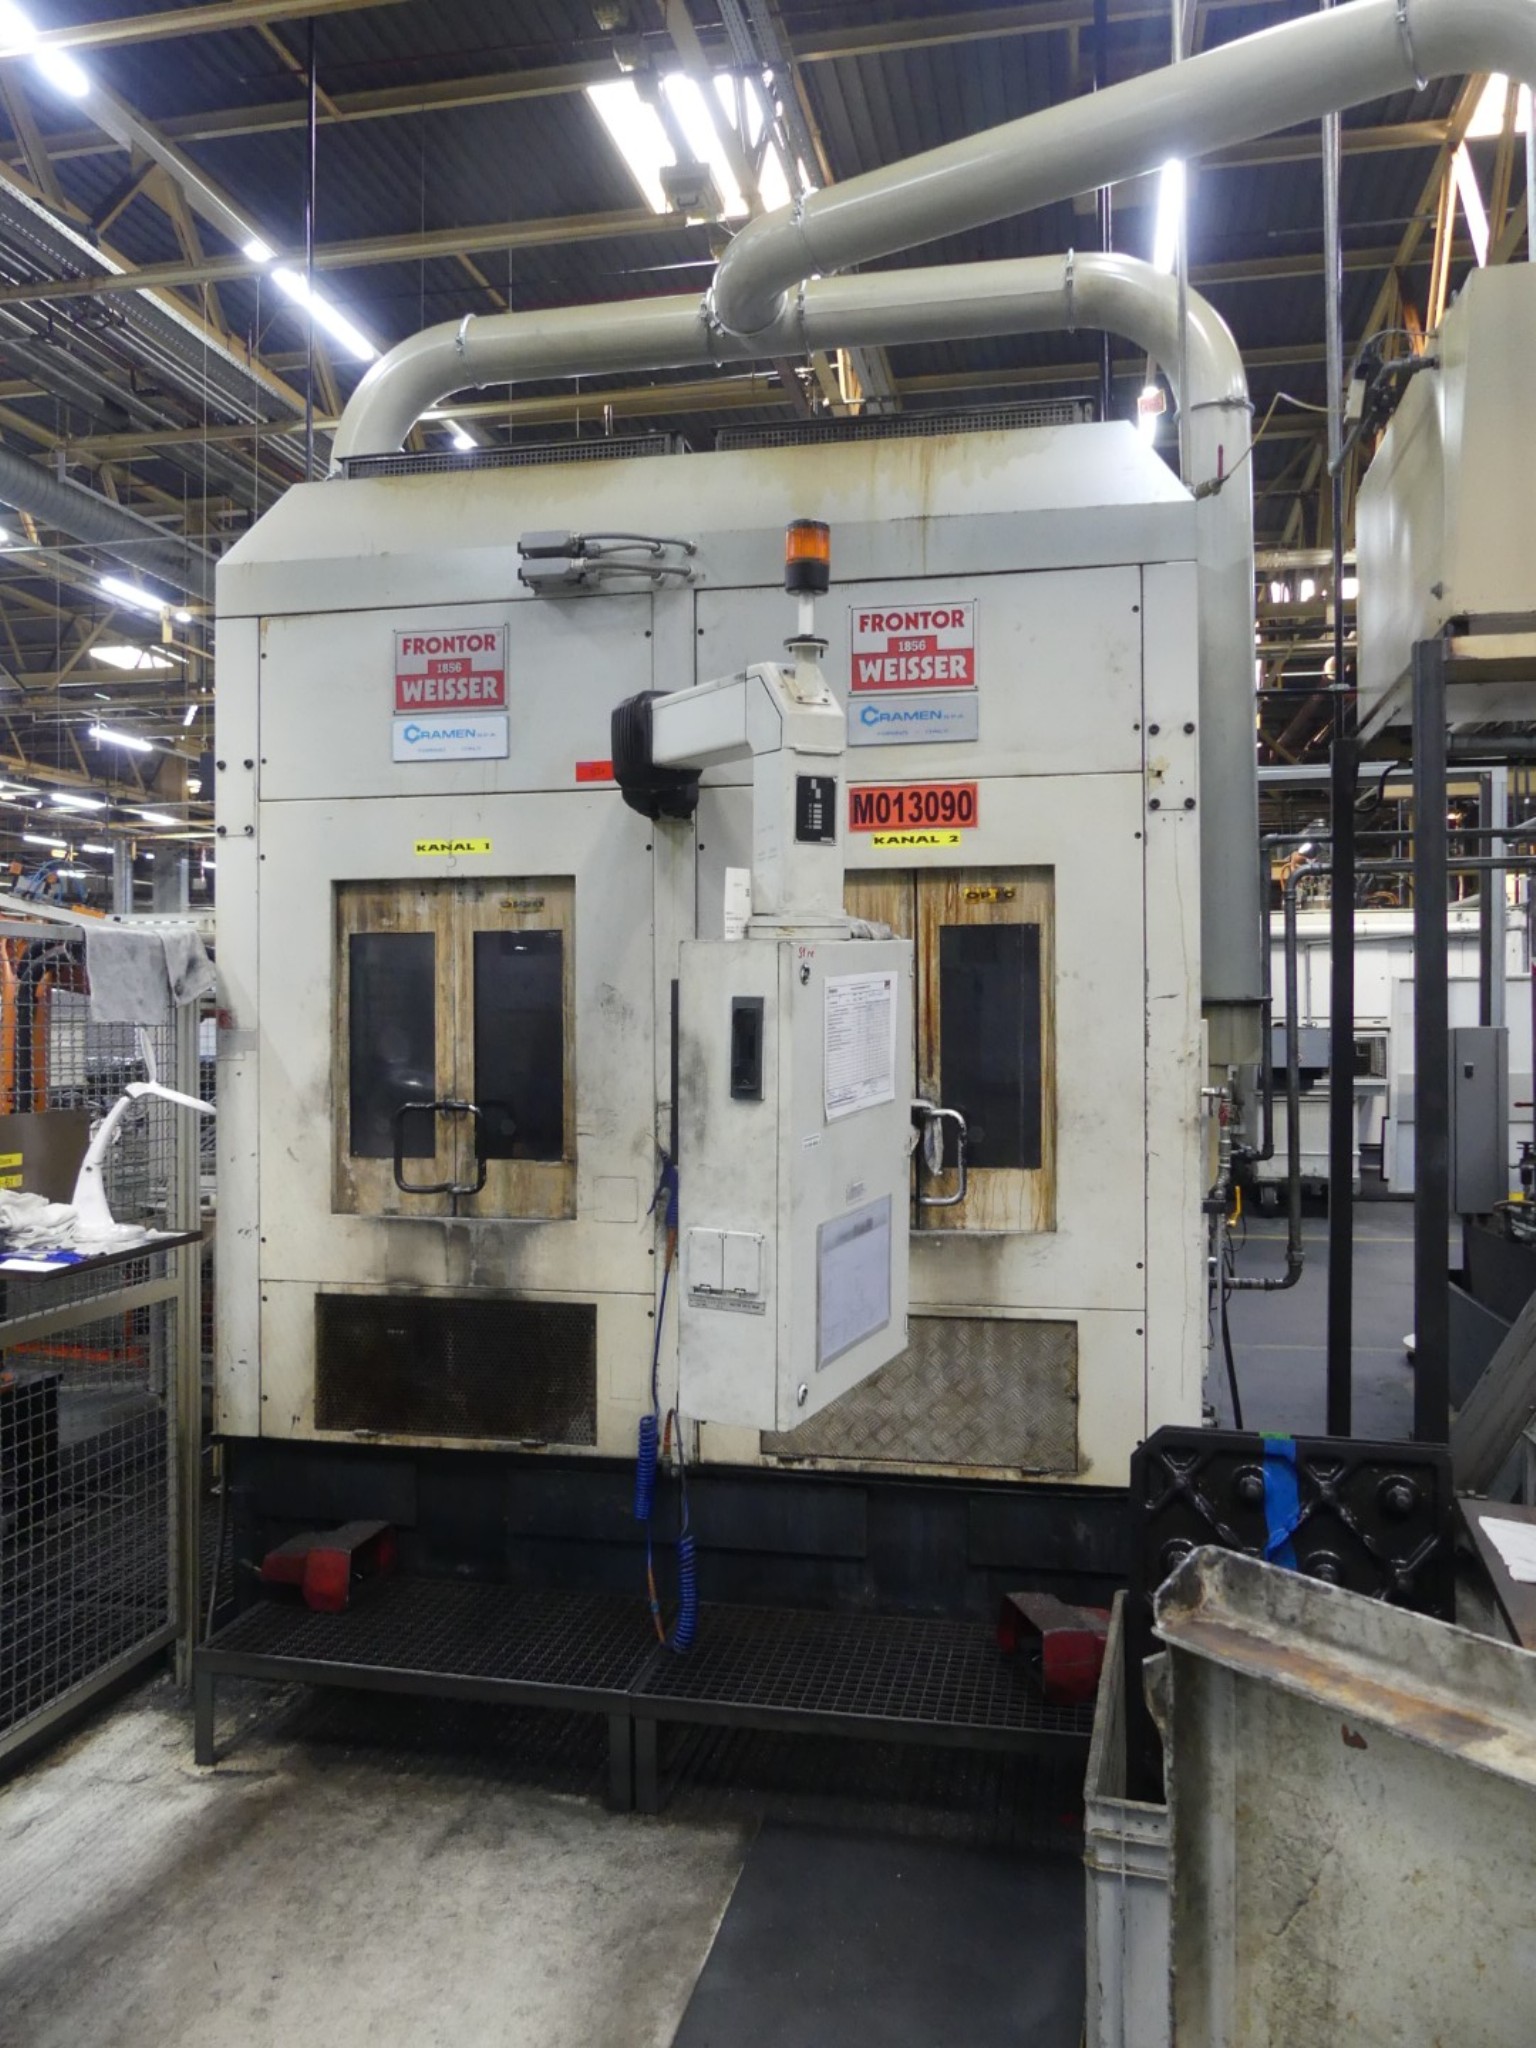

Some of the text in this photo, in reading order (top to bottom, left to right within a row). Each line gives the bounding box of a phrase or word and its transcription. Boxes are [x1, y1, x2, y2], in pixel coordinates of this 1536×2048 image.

[858, 609, 965, 633] FRONTOR
[402, 634, 496, 655] FRONTOR
[898, 640, 926, 652] 1856
[437, 662, 462, 674] 1856
[858, 655, 968, 683] WEISSER
[402, 676, 498, 702] WEISSER
[860, 705, 943, 727] CRAMEN
[403, 724, 476, 744] CRAMEN
[852, 789, 973, 825] M013090
[416, 842, 475, 852] KANAL
[873, 834, 960, 845] KANAL 2
